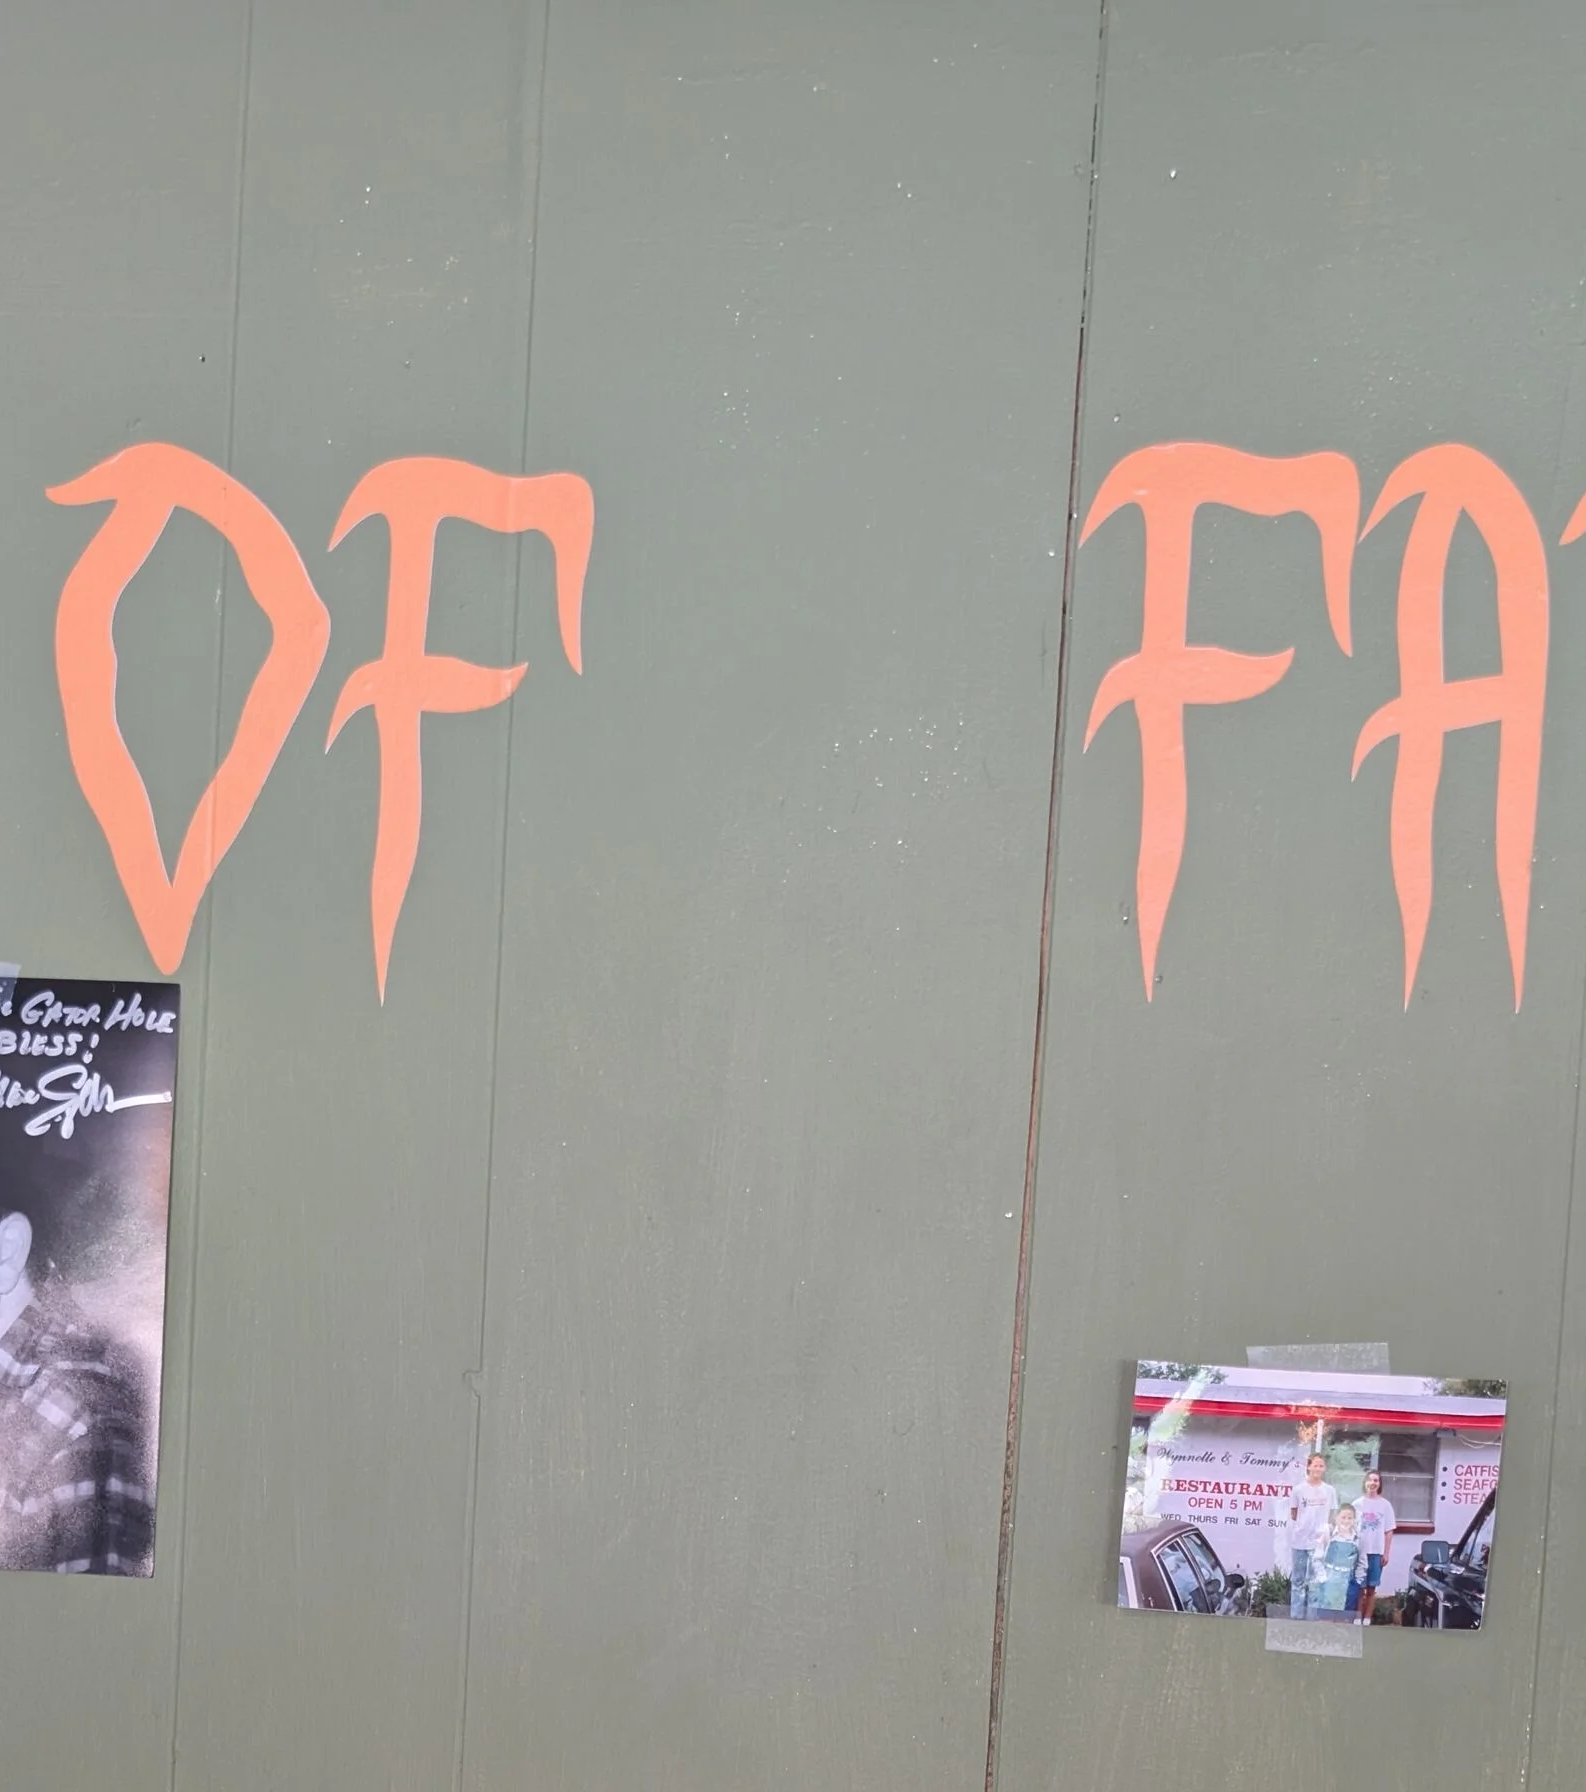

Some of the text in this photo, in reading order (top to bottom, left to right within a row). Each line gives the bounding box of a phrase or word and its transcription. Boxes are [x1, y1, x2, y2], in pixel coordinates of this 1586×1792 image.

[45, 442, 595, 1003] OF
[103, 992, 176, 1033] HOLE
[1220, 1451, 1232, 1466] &
[1160, 1478, 1293, 1497] RESTAURANT
[1188, 1497, 1263, 1511] OPEN 5 PM
[1188, 1514, 1218, 1524] THURS
[1224, 1516, 1239, 1525] FRI
[1244, 1518, 1262, 1526] SAT
[1268, 1519, 1288, 1528] SUN
